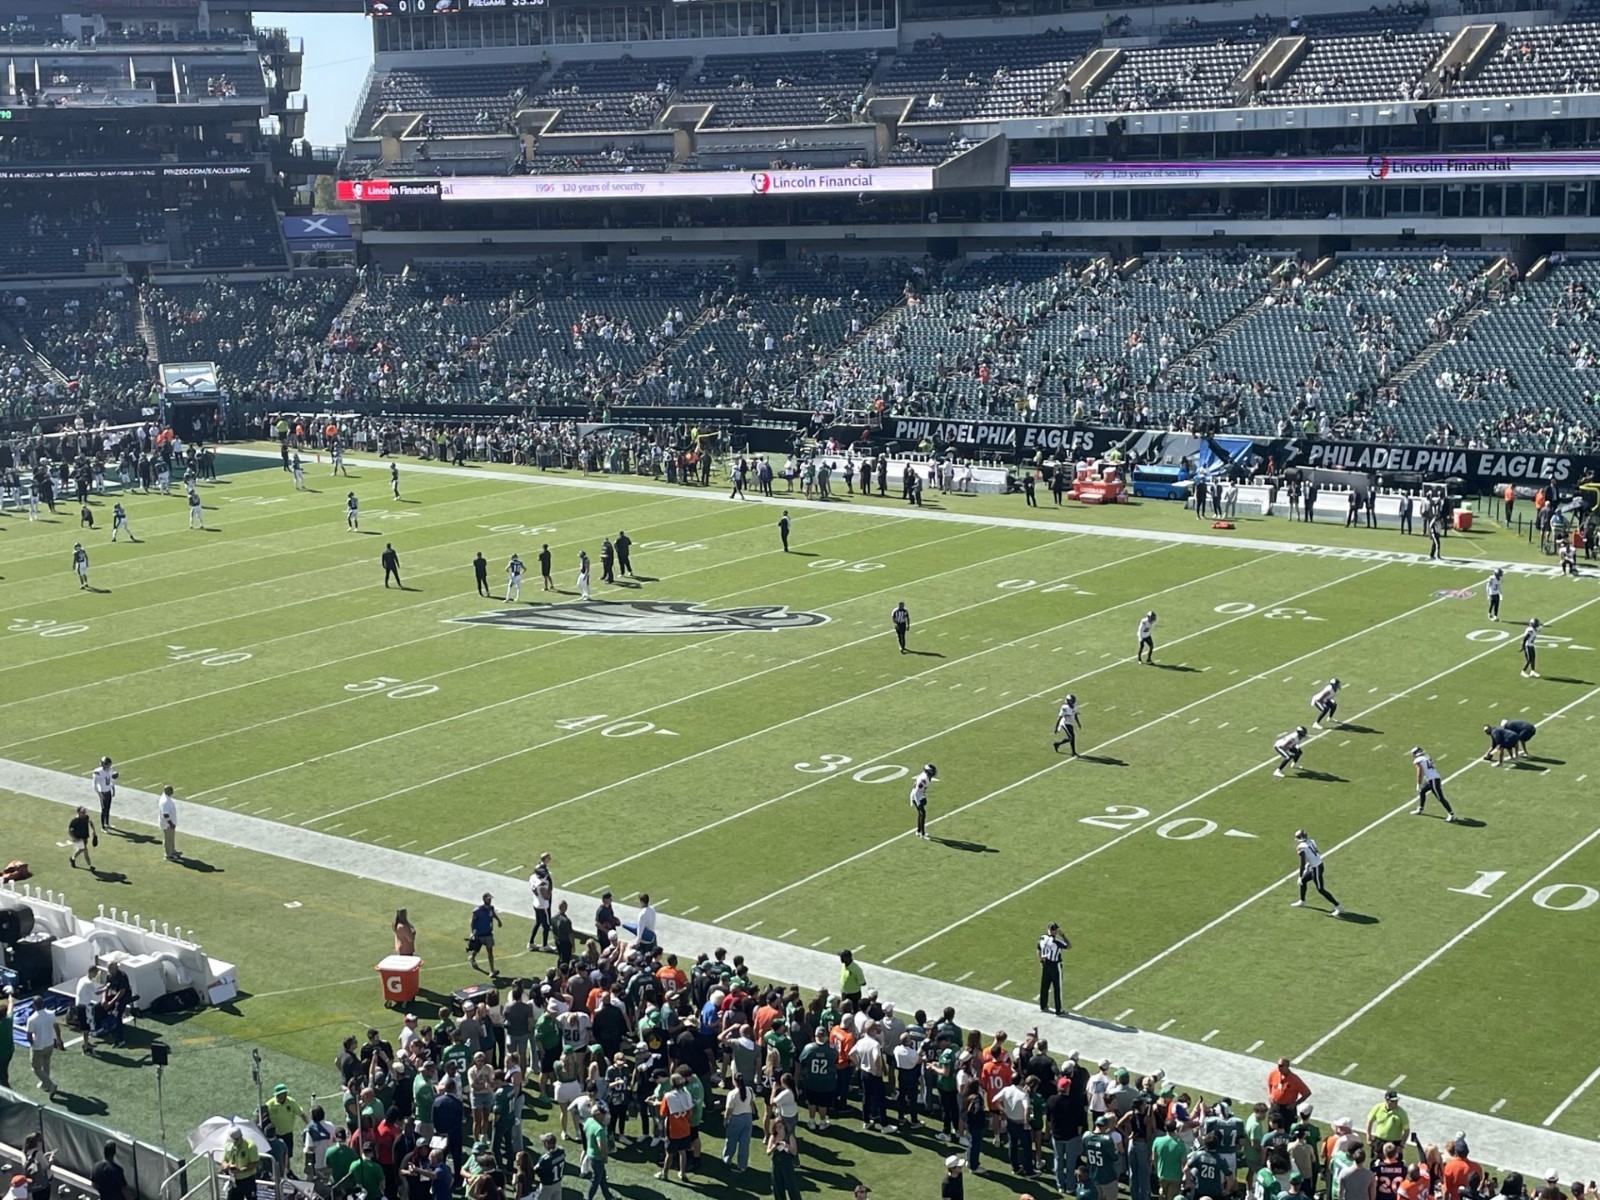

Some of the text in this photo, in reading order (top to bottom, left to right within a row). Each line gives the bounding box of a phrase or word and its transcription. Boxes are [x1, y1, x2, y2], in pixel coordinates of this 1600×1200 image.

[400, 1, 407, 11] 0
[418, 0, 425, 10] 0
[1392, 156, 1512, 173] Lincoln Financial
[773, 174, 873, 188] Lincoln Financial
[1129, 169, 1152, 179] years
[1165, 168, 1200, 179] security
[367, 184, 438, 195] Lincoln Financial
[562, 183, 576, 192] 120
[578, 182, 600, 193] years
[602, 181, 610, 191] of
[612, 180, 645, 192] security
[311, 242, 335, 250] xfinity
[895, 420, 1095, 451] PHILADELPHIA EAGLES
[1308, 443, 1572, 481] PHILADELPHIA EAGLES
[8, 618, 90, 637] 30
[344, 676, 440, 699] 50
[553, 714, 656, 737] 40
[794, 753, 910, 784] 30
[1078, 805, 1219, 840] 20
[1446, 870, 1600, 912] 10
[387, 976, 402, 993] G
[564, 1030, 580, 1042] 20
[811, 1059, 828, 1074] 62
[990, 1076, 1003, 1089] 10
[1087, 1150, 1103, 1167] 65
[1200, 1164, 1216, 1179] 26
